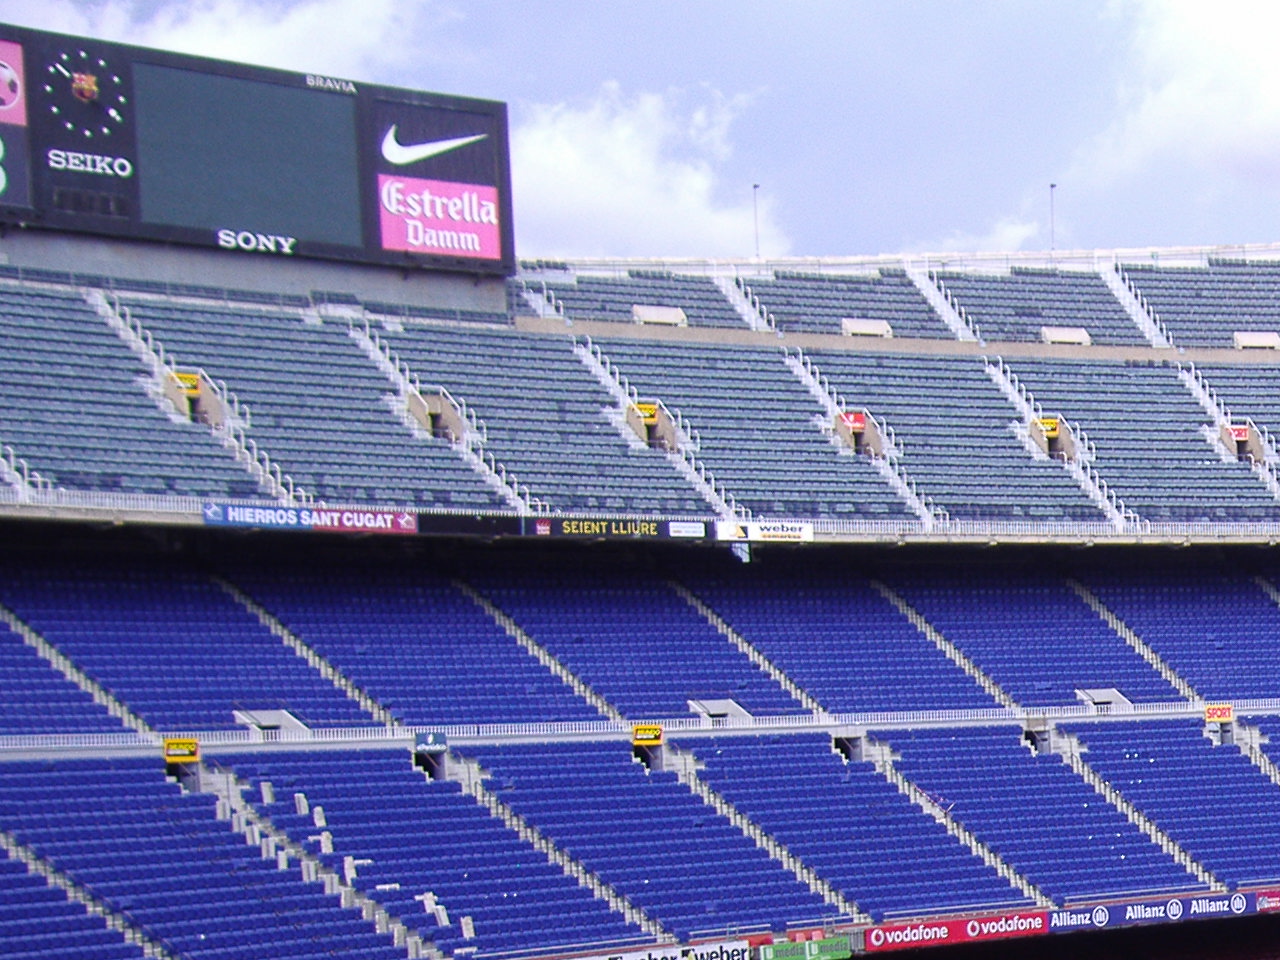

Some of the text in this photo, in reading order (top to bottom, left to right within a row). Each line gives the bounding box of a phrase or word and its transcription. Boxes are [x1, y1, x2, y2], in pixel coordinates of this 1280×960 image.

[305, 74, 359, 95] BRAVIA
[47, 148, 133, 180] SEIKO
[381, 178, 499, 226] Estrella
[216, 229, 298, 255] SONY
[404, 217, 481, 252] Damm
[228, 506, 394, 529] HIERROS SANT CUGAT
[562, 520, 608, 535] SEIENT
[611, 521, 658, 536] LLIURE
[759, 524, 804, 533] weber
[1206, 706, 1232, 719] SPORT
[1125, 904, 1166, 921] Allianz
[1190, 898, 1230, 914] Allianz
[980, 914, 1043, 936] vodafone
[1050, 911, 1091, 928] Allianz
[884, 923, 949, 944] vodafone
